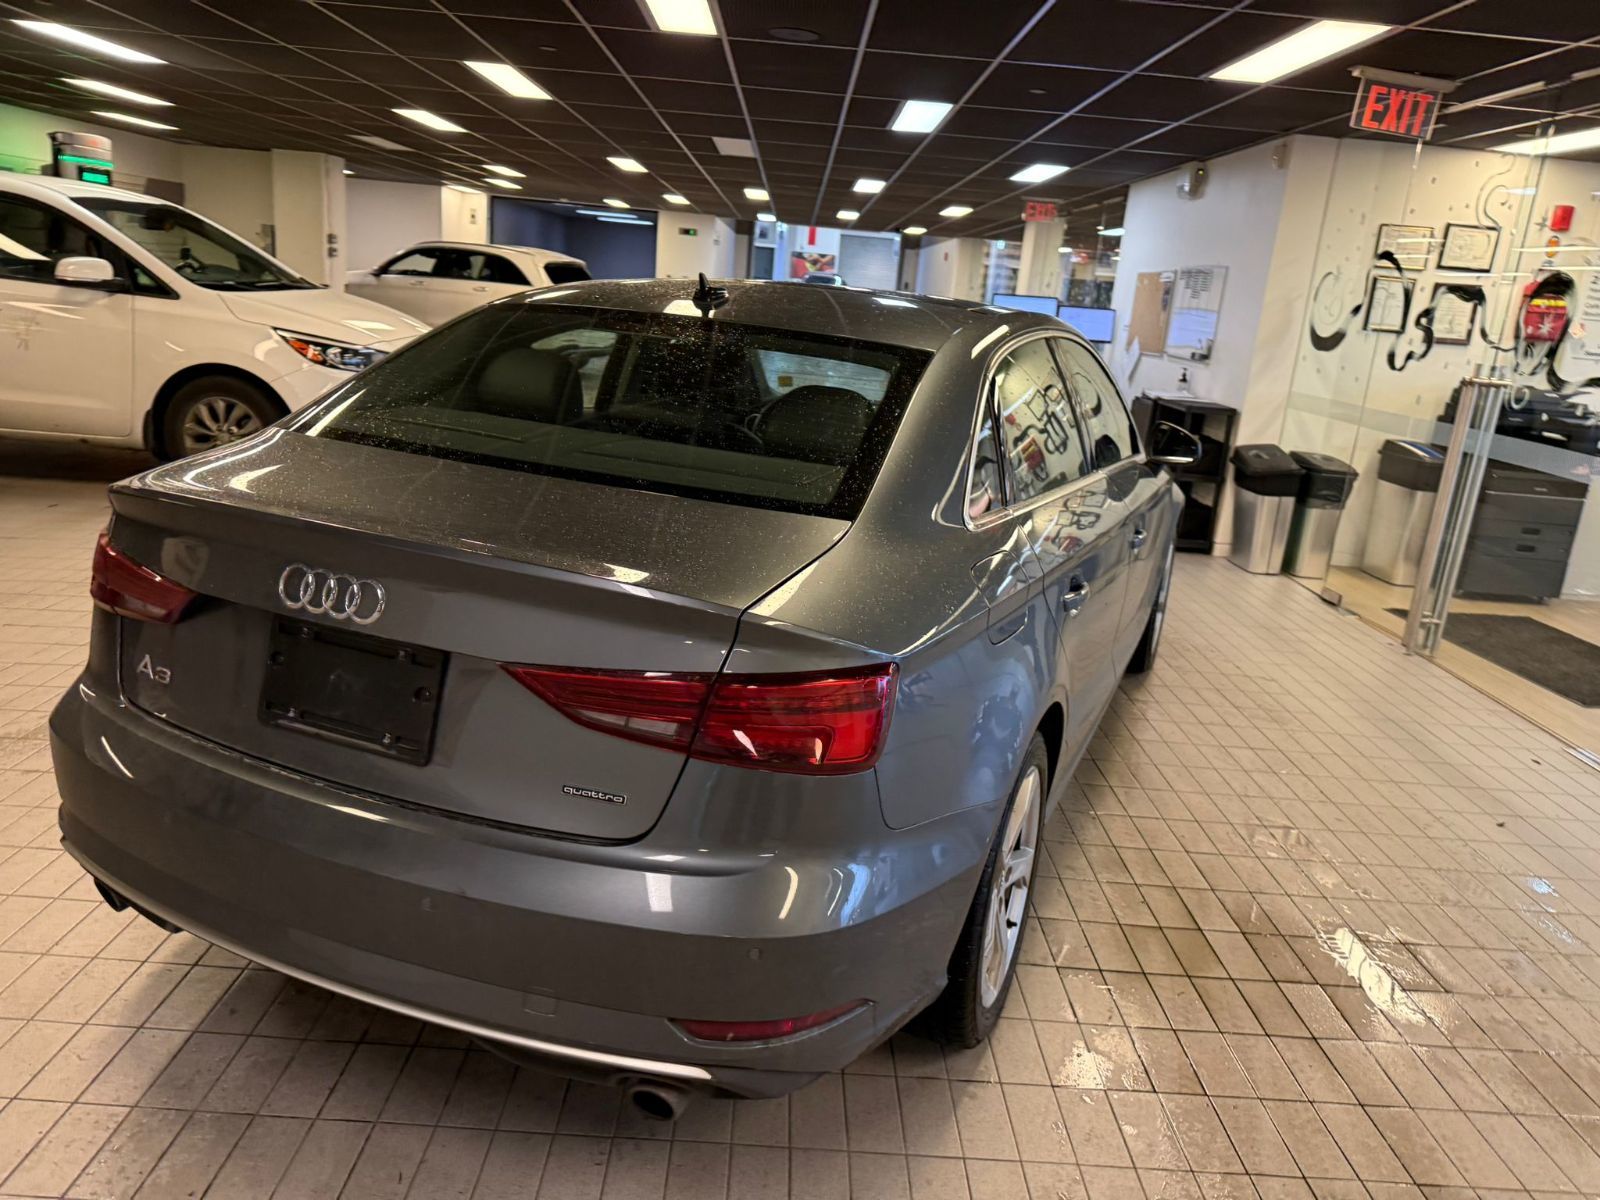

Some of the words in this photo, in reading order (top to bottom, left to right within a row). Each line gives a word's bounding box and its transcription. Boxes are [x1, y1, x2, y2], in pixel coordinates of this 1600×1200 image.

[1361, 85, 1435, 136] EXIT
[136, 653, 171, 684] A3
[562, 786, 624, 803] quattro
